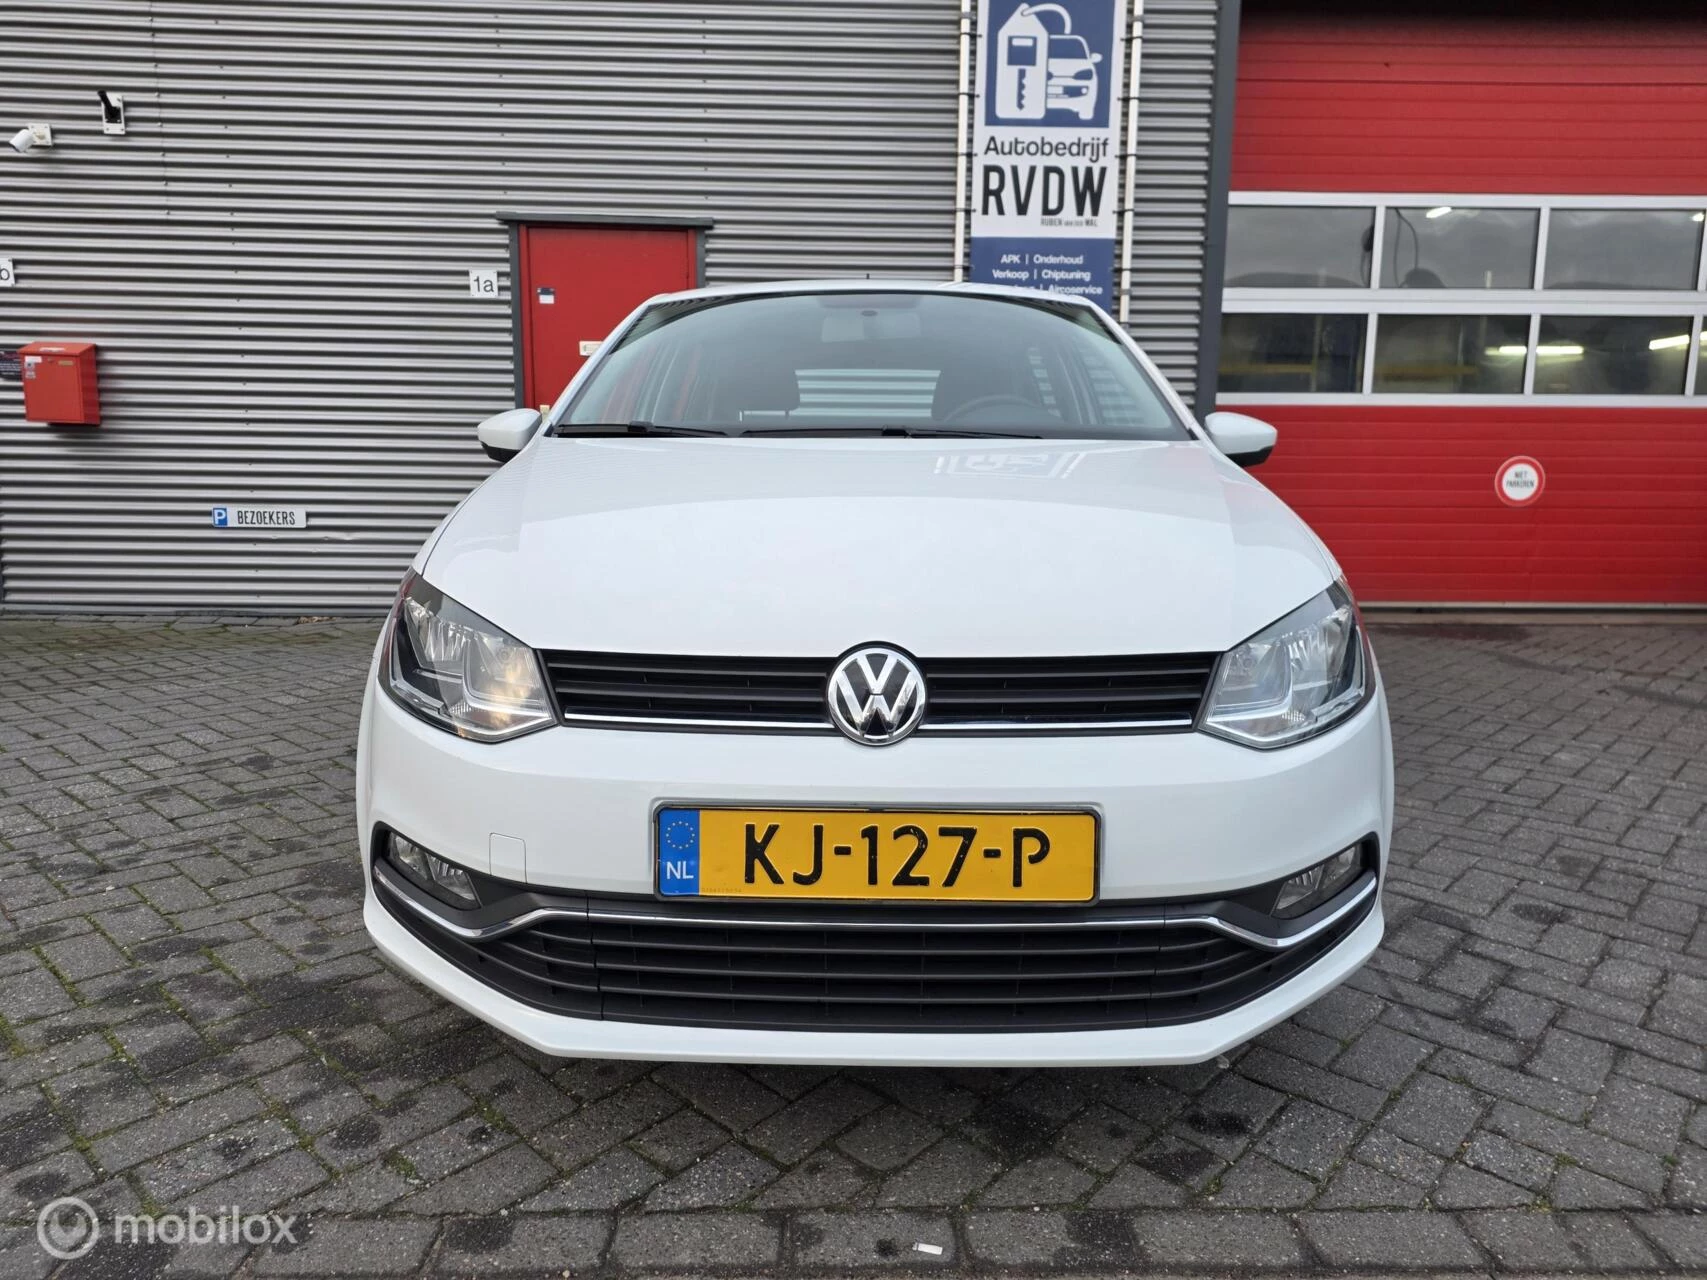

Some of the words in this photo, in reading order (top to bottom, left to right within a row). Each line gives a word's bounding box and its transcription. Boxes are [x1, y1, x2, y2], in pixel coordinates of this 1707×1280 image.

[984, 135, 1109, 163] Autobedrijf
[981, 164, 1108, 217] RVDW
[1001, 254, 1021, 264] APK
[1033, 254, 1084, 265] Onderhoud
[992, 268, 1029, 281] Verkoop
[1041, 269, 1091, 282] Chiptuning
[473, 275, 495, 293] 1a
[1048, 284, 1103, 295] Aircoservice
[213, 509, 226, 525] P
[237, 510, 296, 526] BEZOEKERS
[665, 860, 694, 880] NL
[743, 822, 1052, 888] KJ-127-P
